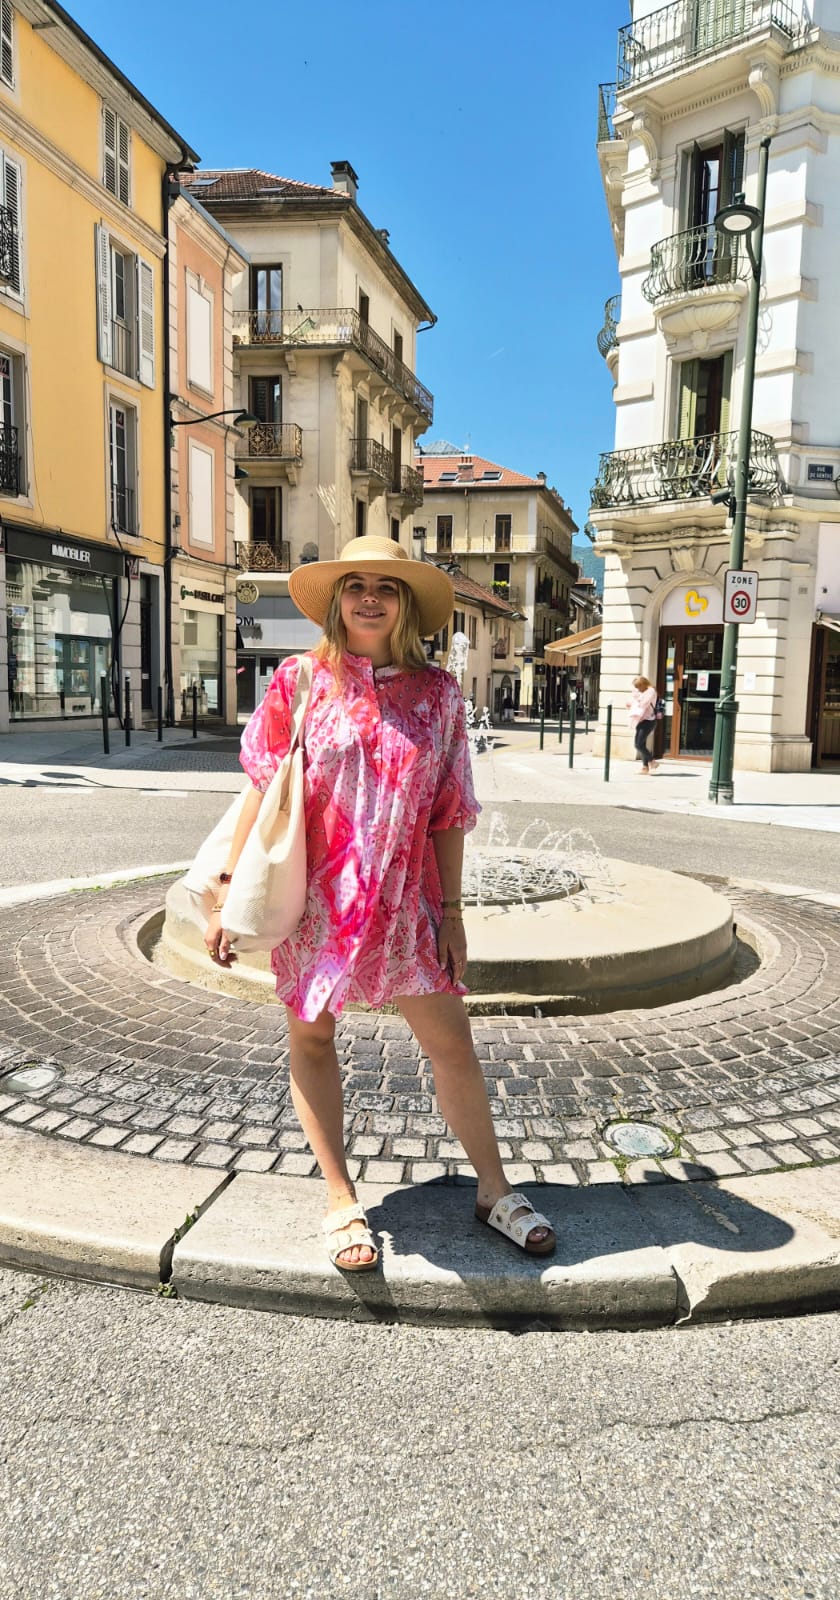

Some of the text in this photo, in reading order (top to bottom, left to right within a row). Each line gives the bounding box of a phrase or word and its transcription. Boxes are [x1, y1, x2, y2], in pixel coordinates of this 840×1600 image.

[51, 544, 91, 563] IMMOBILIER
[731, 576, 753, 585] ZONE
[735, 597, 747, 609] 30
